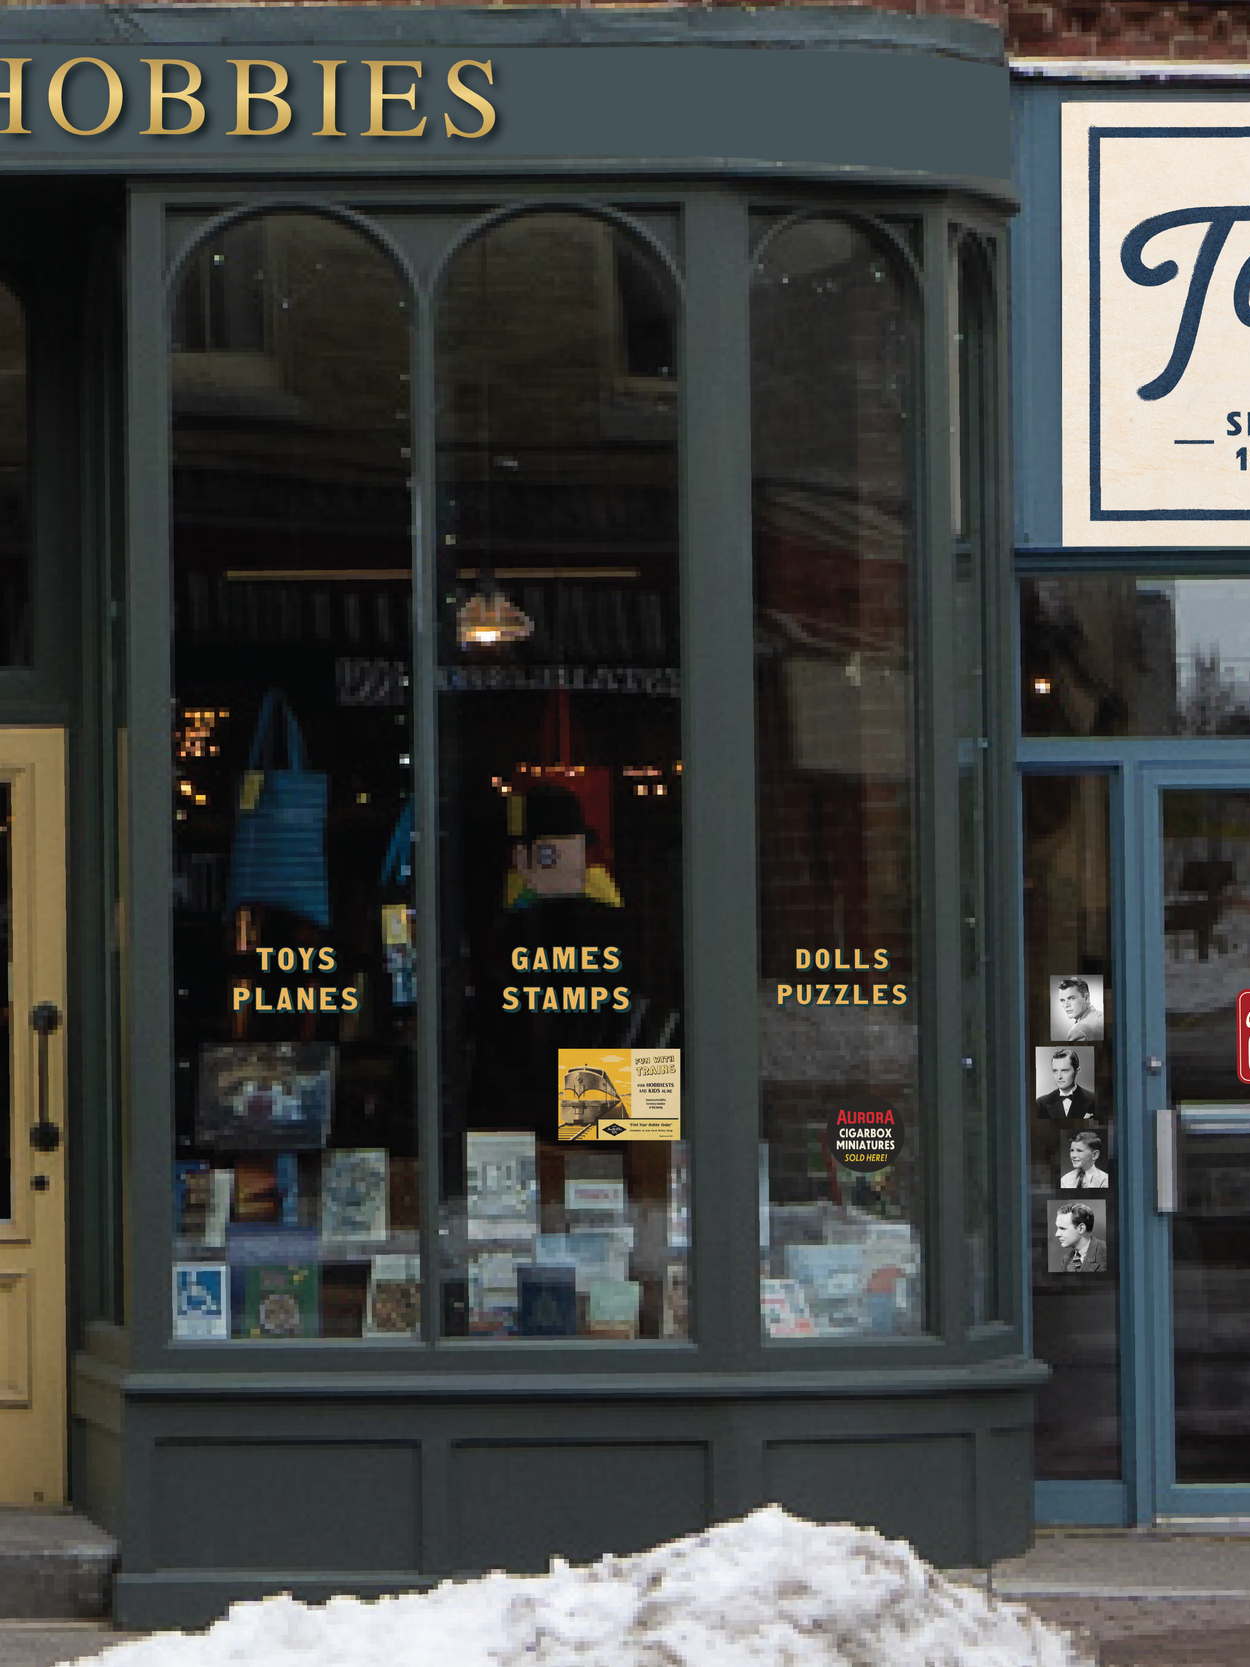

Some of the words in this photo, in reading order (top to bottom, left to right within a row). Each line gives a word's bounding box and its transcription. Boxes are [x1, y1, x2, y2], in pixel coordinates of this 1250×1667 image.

[255, 946, 338, 973] TOYS
[511, 946, 623, 972] GAMES
[795, 948, 891, 972] DOLLS
[232, 987, 361, 1013] PLANES
[502, 986, 632, 1013] STAMPS
[777, 984, 909, 1007] PUZZLES
[653, 1055, 675, 1064] WITH
[636, 1064, 677, 1077] TRAINS
[836, 1109, 895, 1125] AURORA
[839, 1128, 892, 1138] CIGARBOX
[836, 1140, 895, 1150] MINIATURES
[844, 1153, 865, 1162] SOLD
[866, 1153, 888, 1162] HERE!
